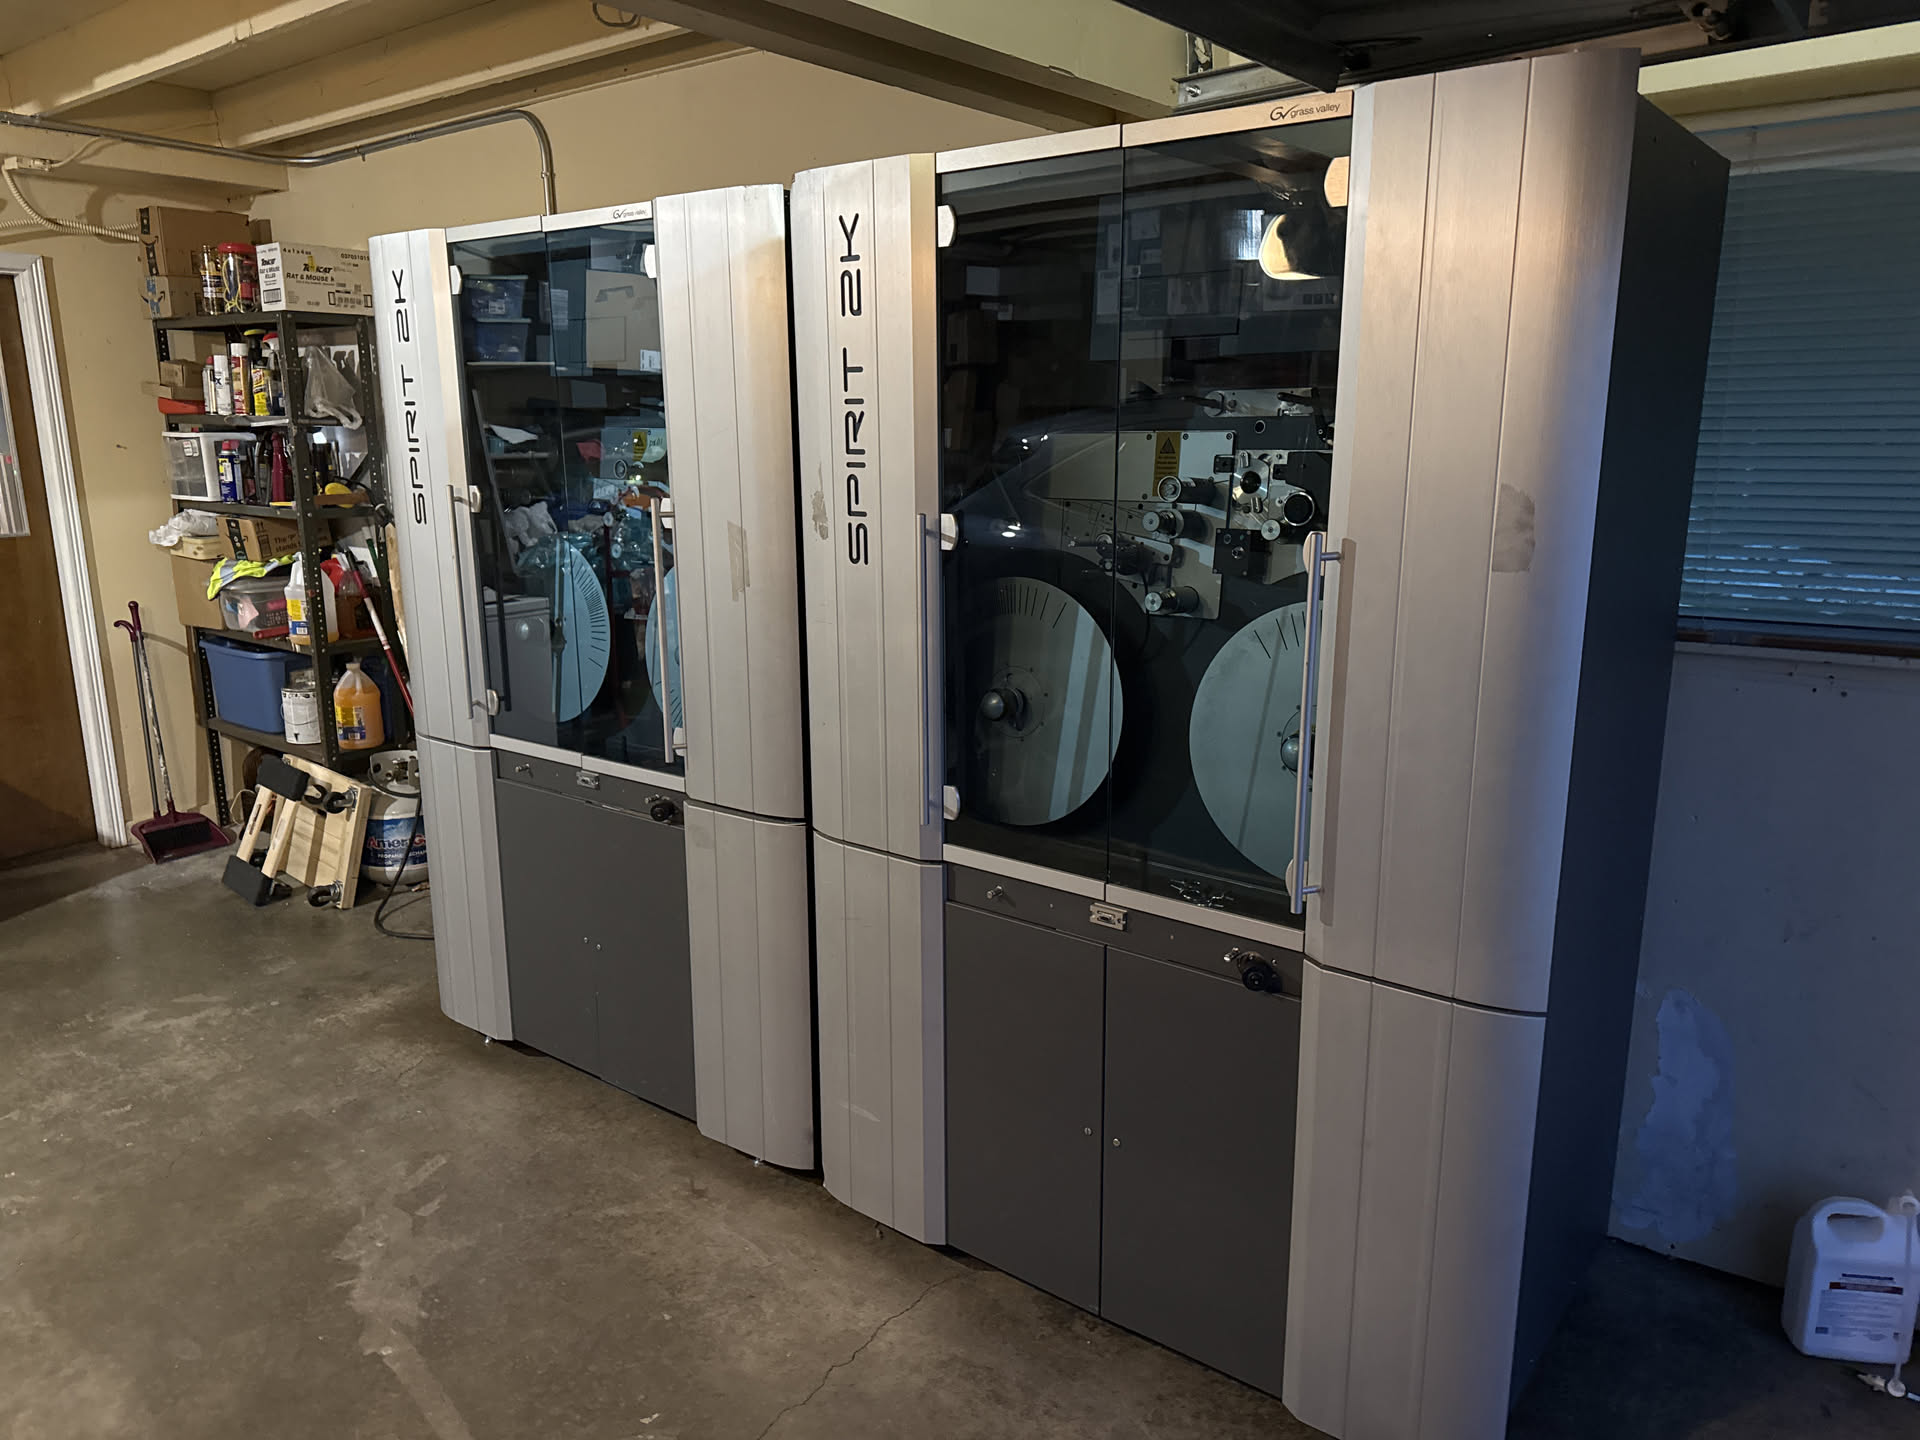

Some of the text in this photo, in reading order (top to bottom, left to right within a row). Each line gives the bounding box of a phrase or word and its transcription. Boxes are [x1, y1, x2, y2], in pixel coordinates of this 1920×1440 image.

[1290, 107, 1314, 118] grass
[1315, 103, 1340, 113] valley
[392, 269, 427, 525] SPIRIT 2K
[839, 213, 868, 565] SPIRIT 2K
